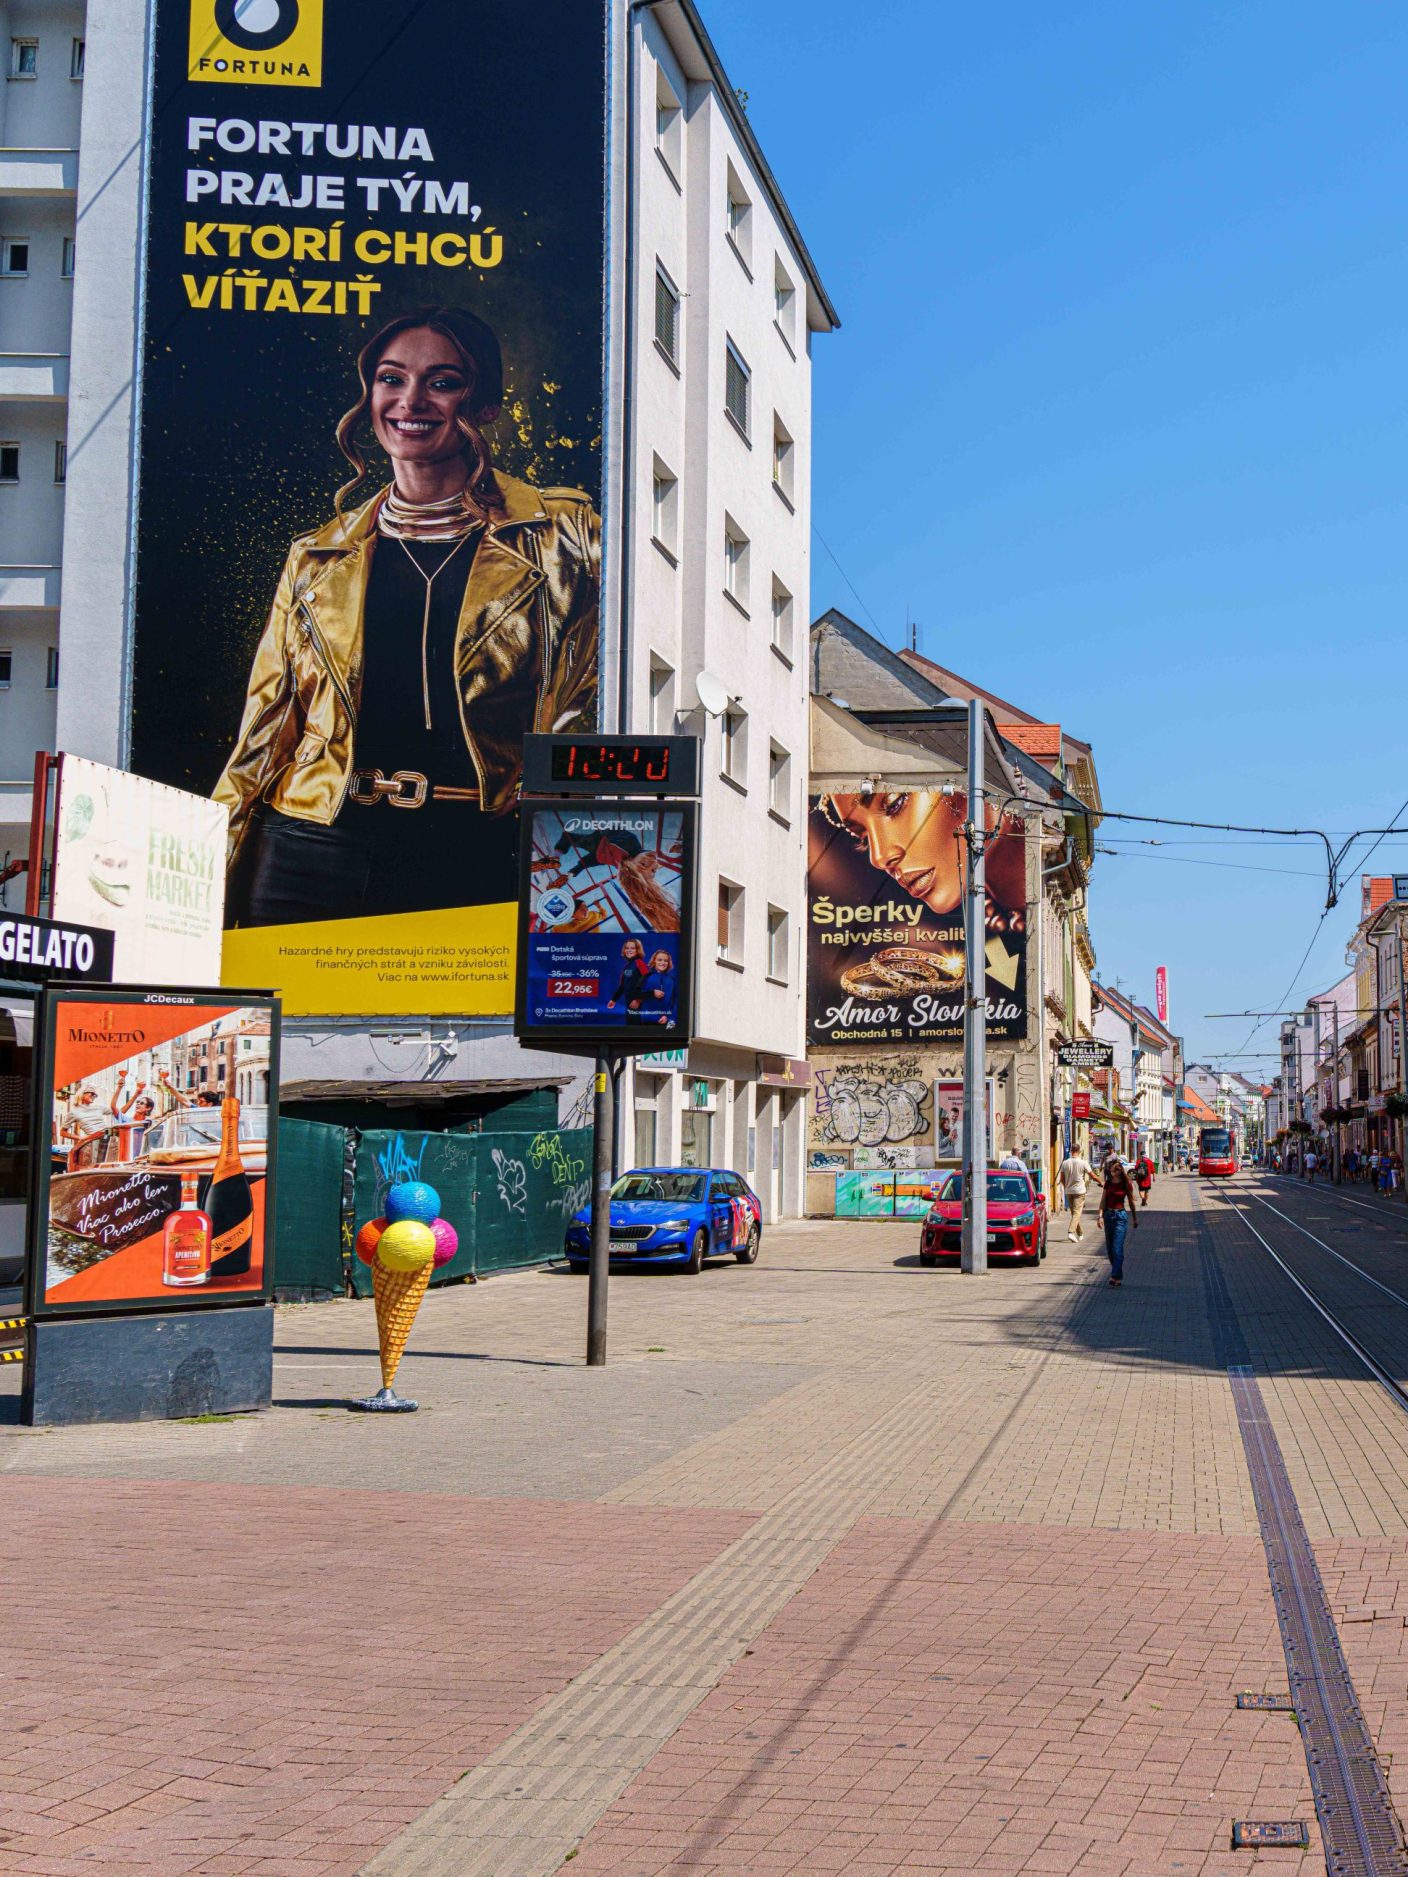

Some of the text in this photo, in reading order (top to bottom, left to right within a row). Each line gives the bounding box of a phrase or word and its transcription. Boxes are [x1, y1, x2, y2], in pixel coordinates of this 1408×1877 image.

[199, 57, 311, 77] FORTUNA
[187, 117, 434, 162] FORTUNA
[186, 169, 482, 222] PRAJE TÝM,
[184, 220, 503, 268] KTORÍ CHCÚ
[182, 268, 381, 316] VÍŤAZIŤ
[582, 820, 654, 831] DECATHLON
[148, 830, 214, 880] FRESH
[145, 868, 213, 913] MARKET
[812, 896, 924, 928] Šperky
[0, 921, 95, 972] GELATO
[279, 945, 510, 958] Hazardné hry predstavujú riziko vysokých
[821, 927, 967, 946] najvyššej kvalit
[315, 958, 510, 971] finančných strát a vzniku závislosti.
[377, 972, 510, 982] Viac na www.ifortuna.sk
[576, 969, 600, 978] -36%
[144, 994, 195, 1005] JCDecaux
[554, 981, 593, 995] 22,95€
[814, 994, 1022, 1029] Amor Slovkia
[68, 1028, 145, 1043] MIONETTO
[831, 1026, 1008, 1040] Obchodná 15 amorsloa.sk
[77, 1169, 156, 1216] Mionetto.
[77, 1184, 169, 1233] Viac ako len
[99, 1208, 164, 1244] Prosecco.
